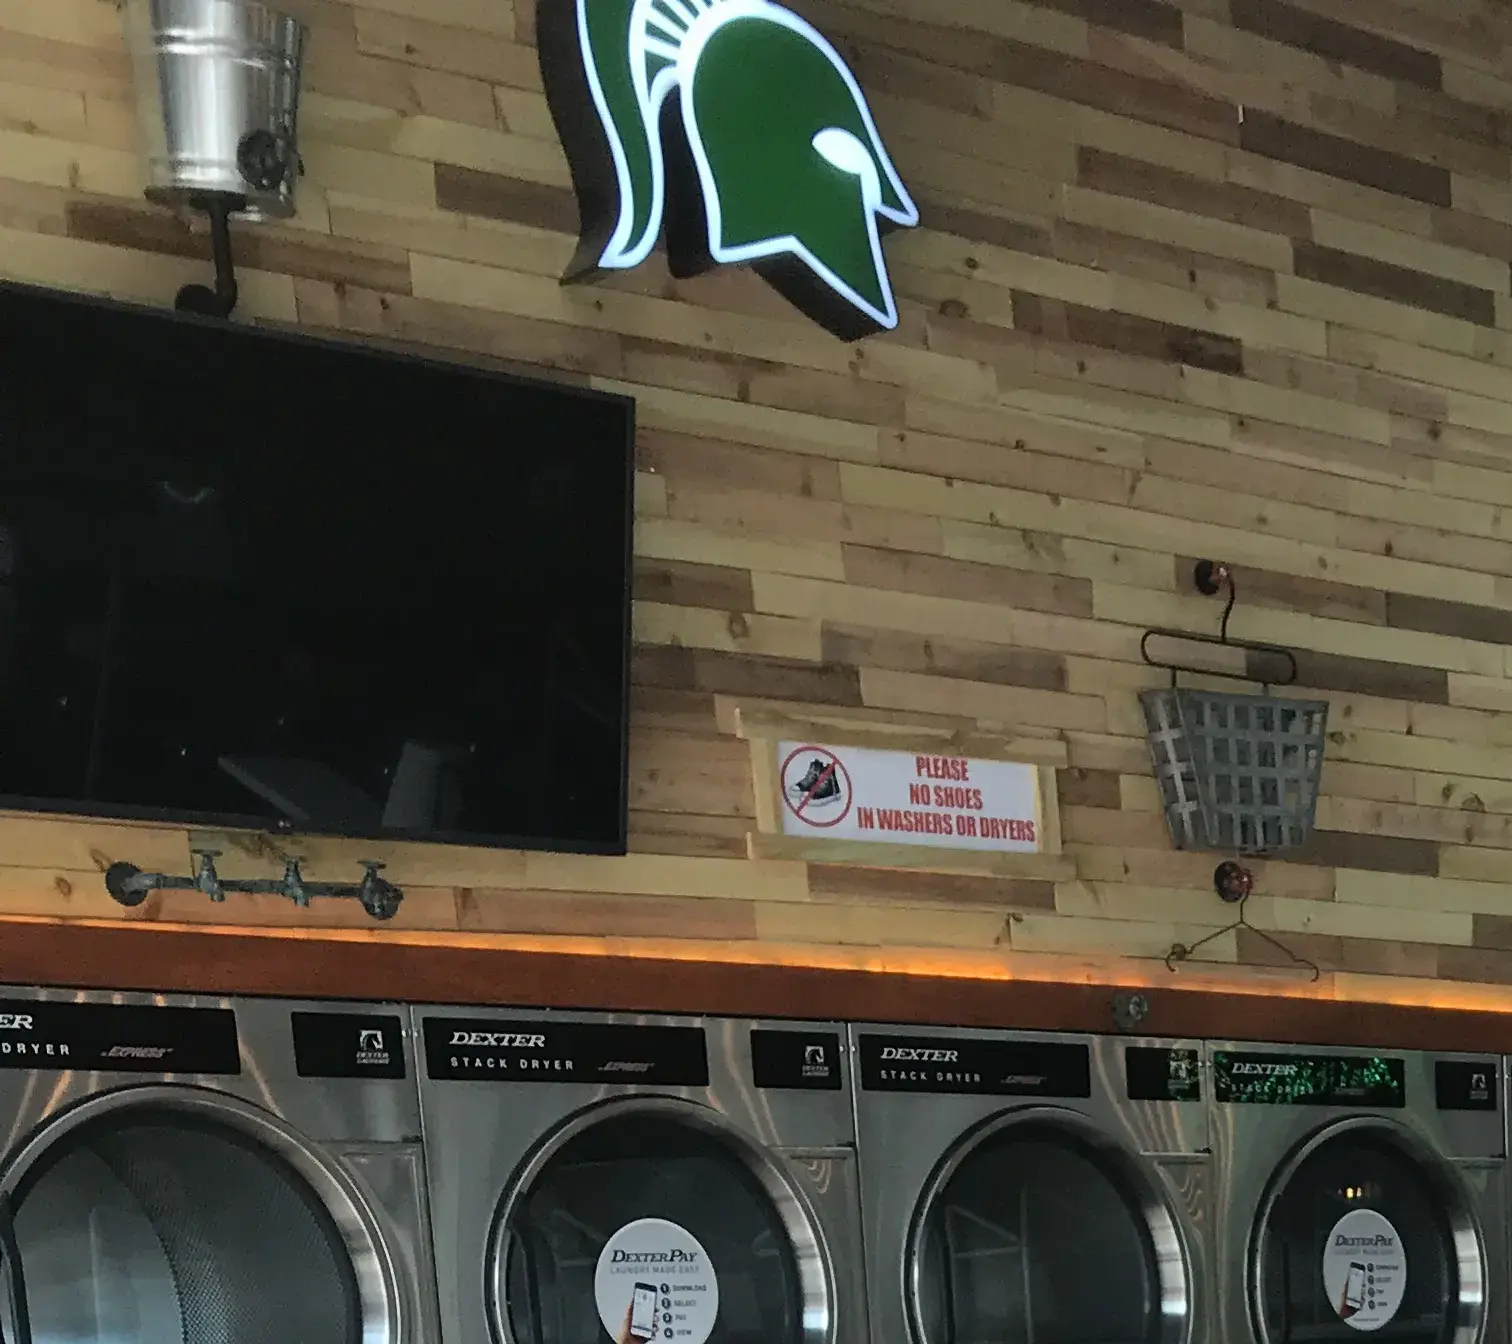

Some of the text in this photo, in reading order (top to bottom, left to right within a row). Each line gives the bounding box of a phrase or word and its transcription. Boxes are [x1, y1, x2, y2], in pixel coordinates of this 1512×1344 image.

[915, 756, 969, 782] PLEASE
[909, 783, 984, 811] NO SHOES
[857, 806, 1036, 842] IN WASHERS OR DRYERS
[449, 1031, 546, 1049] DEXTER
[1, 1042, 71, 1056] DRYER
[880, 1047, 959, 1062] DEXTER
[450, 1056, 508, 1069] STACK
[520, 1058, 574, 1071] DRYER
[1231, 1062, 1298, 1075] DEXTER
[880, 1070, 982, 1083] STACK DRYER
[610, 1249, 698, 1263] DEXTERPAY
